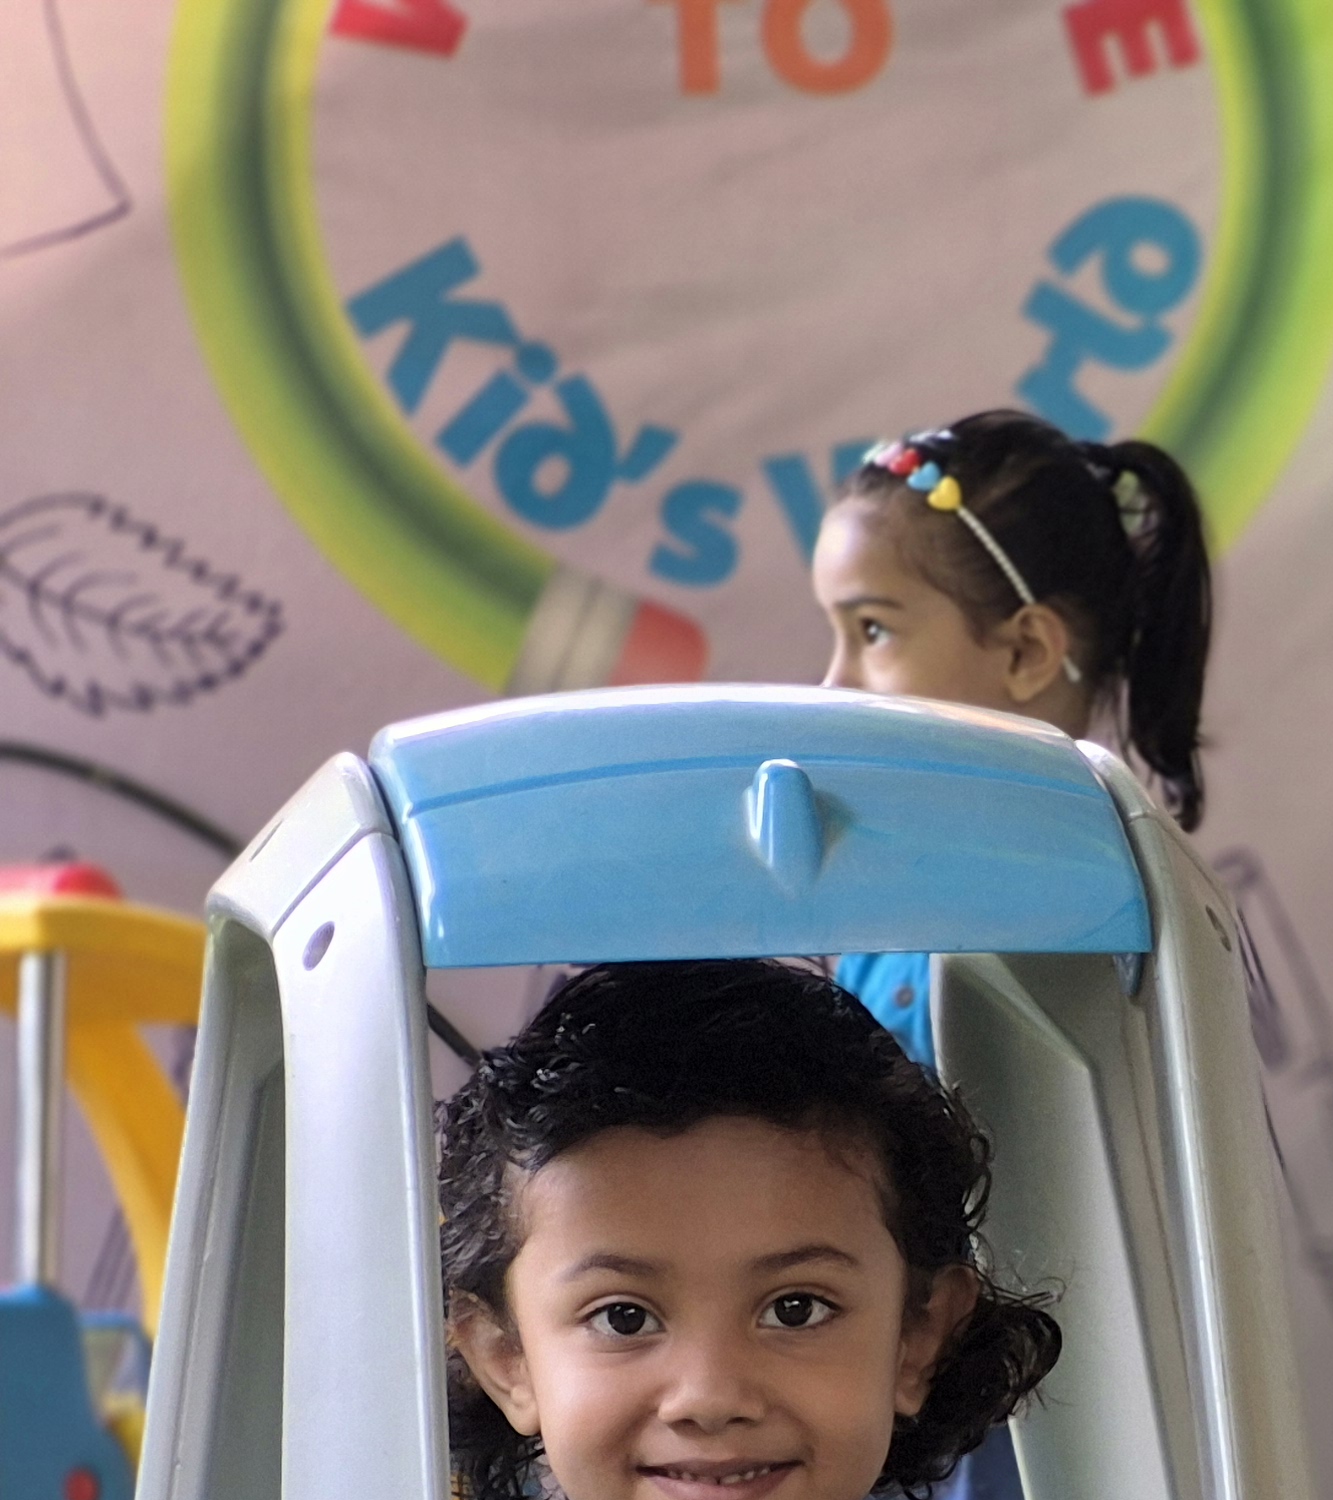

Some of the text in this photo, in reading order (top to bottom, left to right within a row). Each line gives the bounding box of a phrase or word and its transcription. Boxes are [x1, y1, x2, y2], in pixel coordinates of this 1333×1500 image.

[645, 0, 894, 95] TO
[345, 194, 1205, 589] Kid's rld
